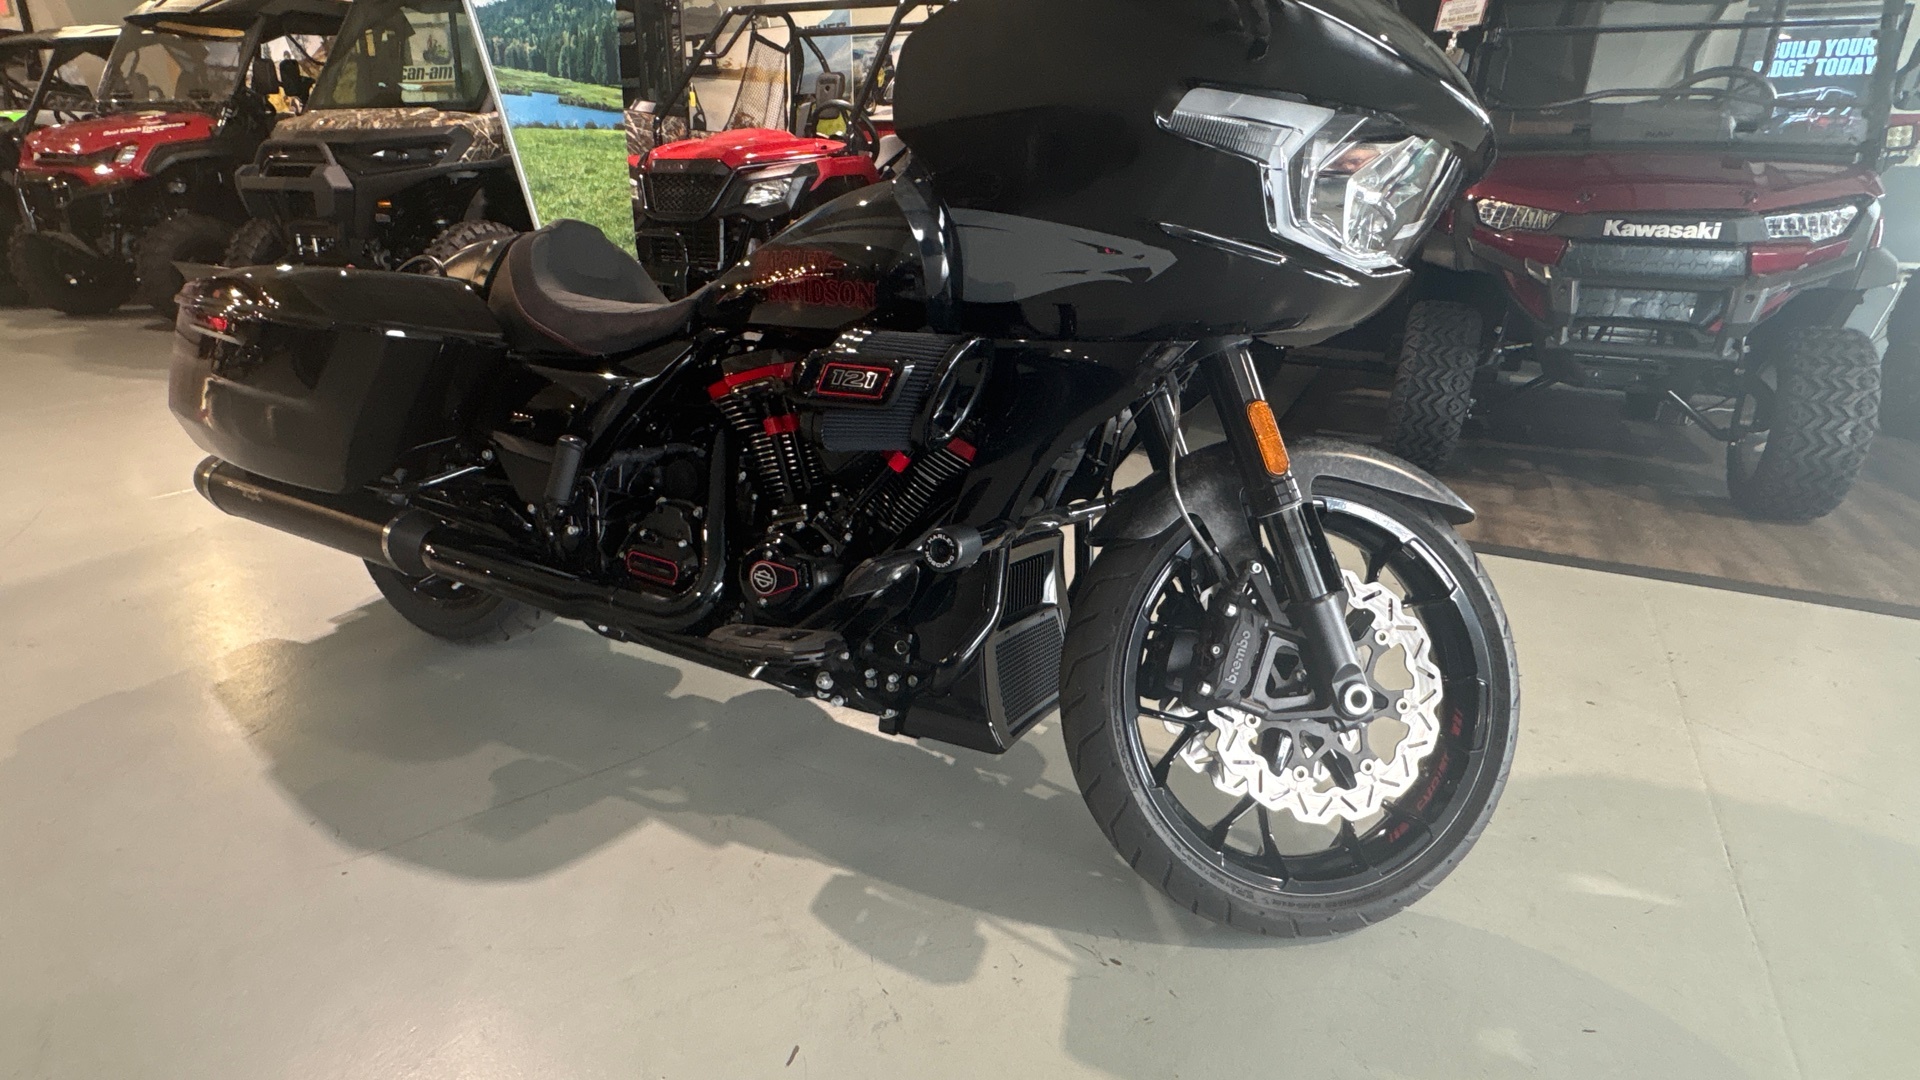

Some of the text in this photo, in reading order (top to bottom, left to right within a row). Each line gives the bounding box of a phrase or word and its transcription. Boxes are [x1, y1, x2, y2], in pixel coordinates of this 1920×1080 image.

[1825, 36, 1878, 58] YOUR
[1815, 55, 1878, 77] TODAY
[1603, 219, 1723, 239] Kawasaki
[831, 369, 878, 389] 121
[1224, 630, 1251, 685] brembo
